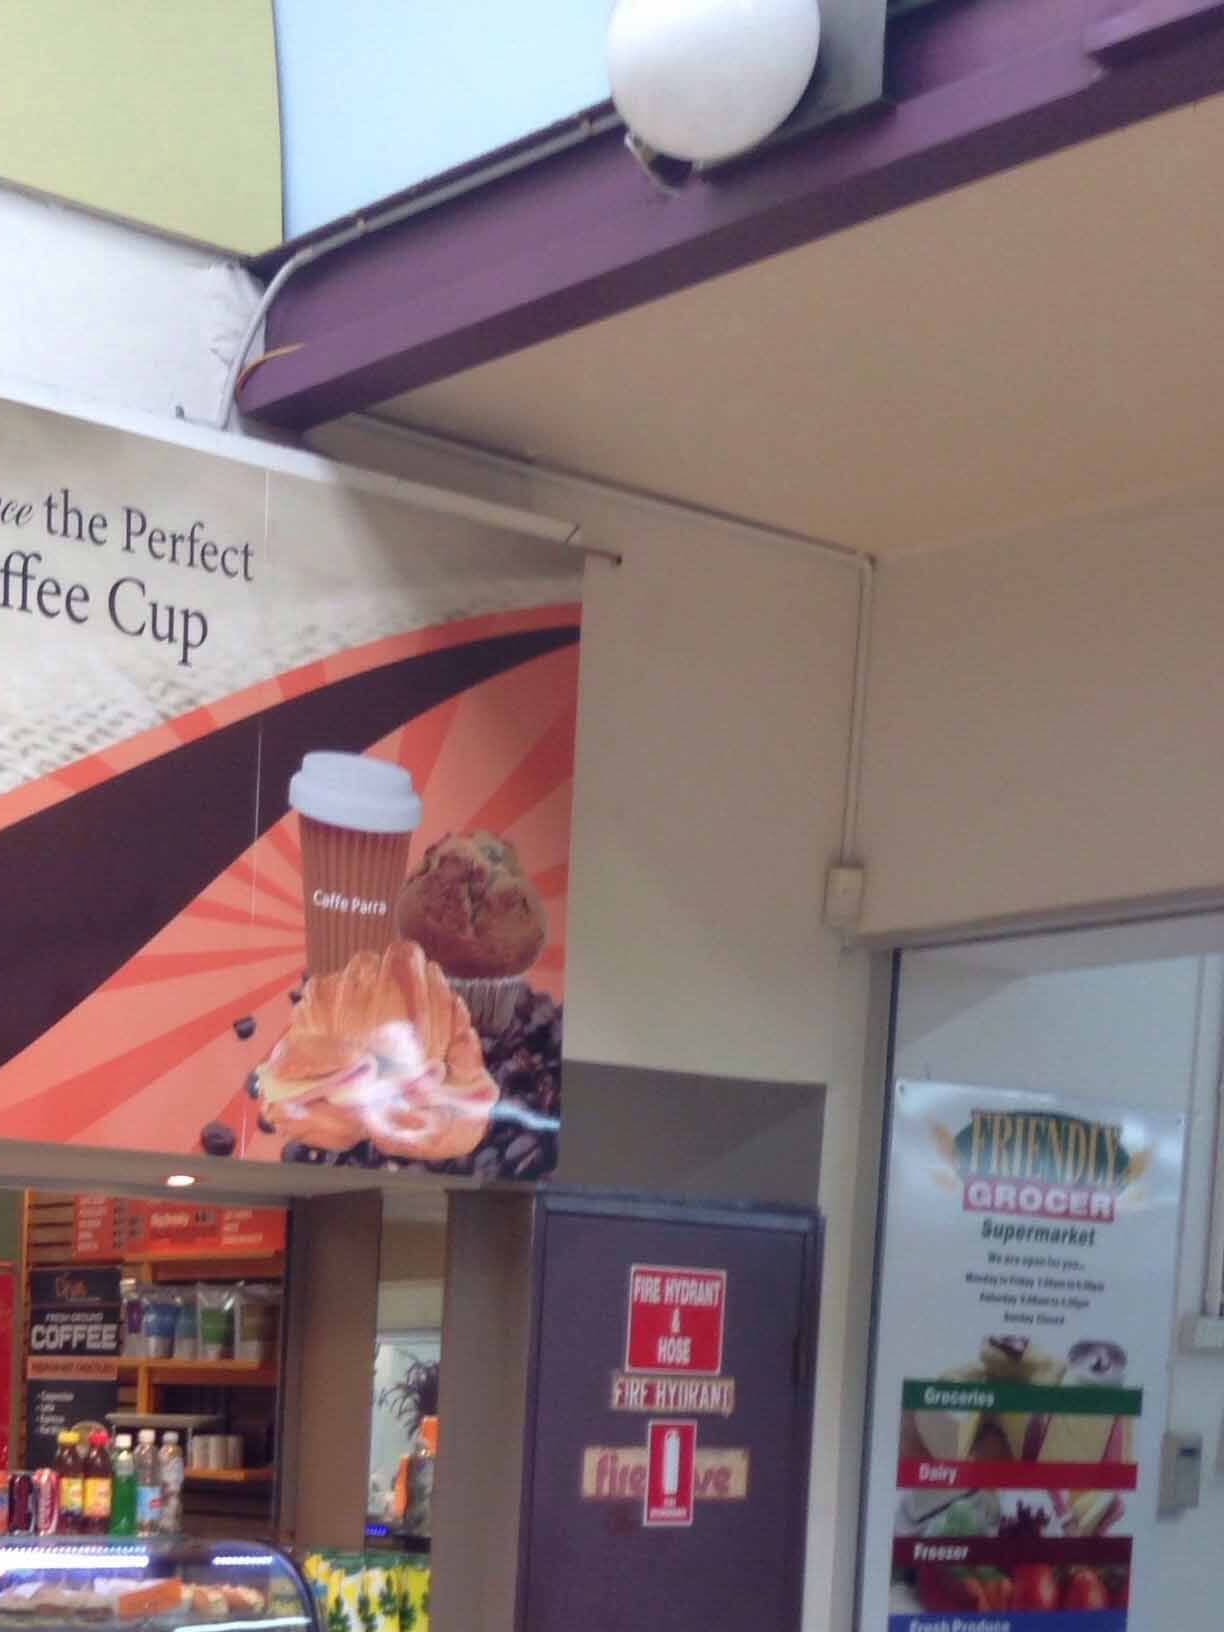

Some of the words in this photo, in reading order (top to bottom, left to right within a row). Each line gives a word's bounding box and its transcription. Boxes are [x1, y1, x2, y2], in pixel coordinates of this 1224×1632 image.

[44, 488, 108, 546] the
[121, 506, 256, 582] Perfect
[108, 576, 209, 668] Cup
[970, 1110, 1122, 1188] FRIENDLY
[967, 1180, 1113, 1218] GROCER
[981, 1218, 1096, 1247] Supermarket
[633, 1274, 662, 1304] FIRE
[664, 1277, 722, 1307] HYDRANT
[31, 1323, 118, 1350] COFFEE
[657, 1336, 692, 1366] HOSE
[614, 1376, 650, 1409] FIRE
[655, 1378, 732, 1415] HYDRANT
[924, 1385, 995, 1408] Groceries
[919, 1462, 958, 1483] Dairy
[913, 1542, 969, 1561] Freezer
